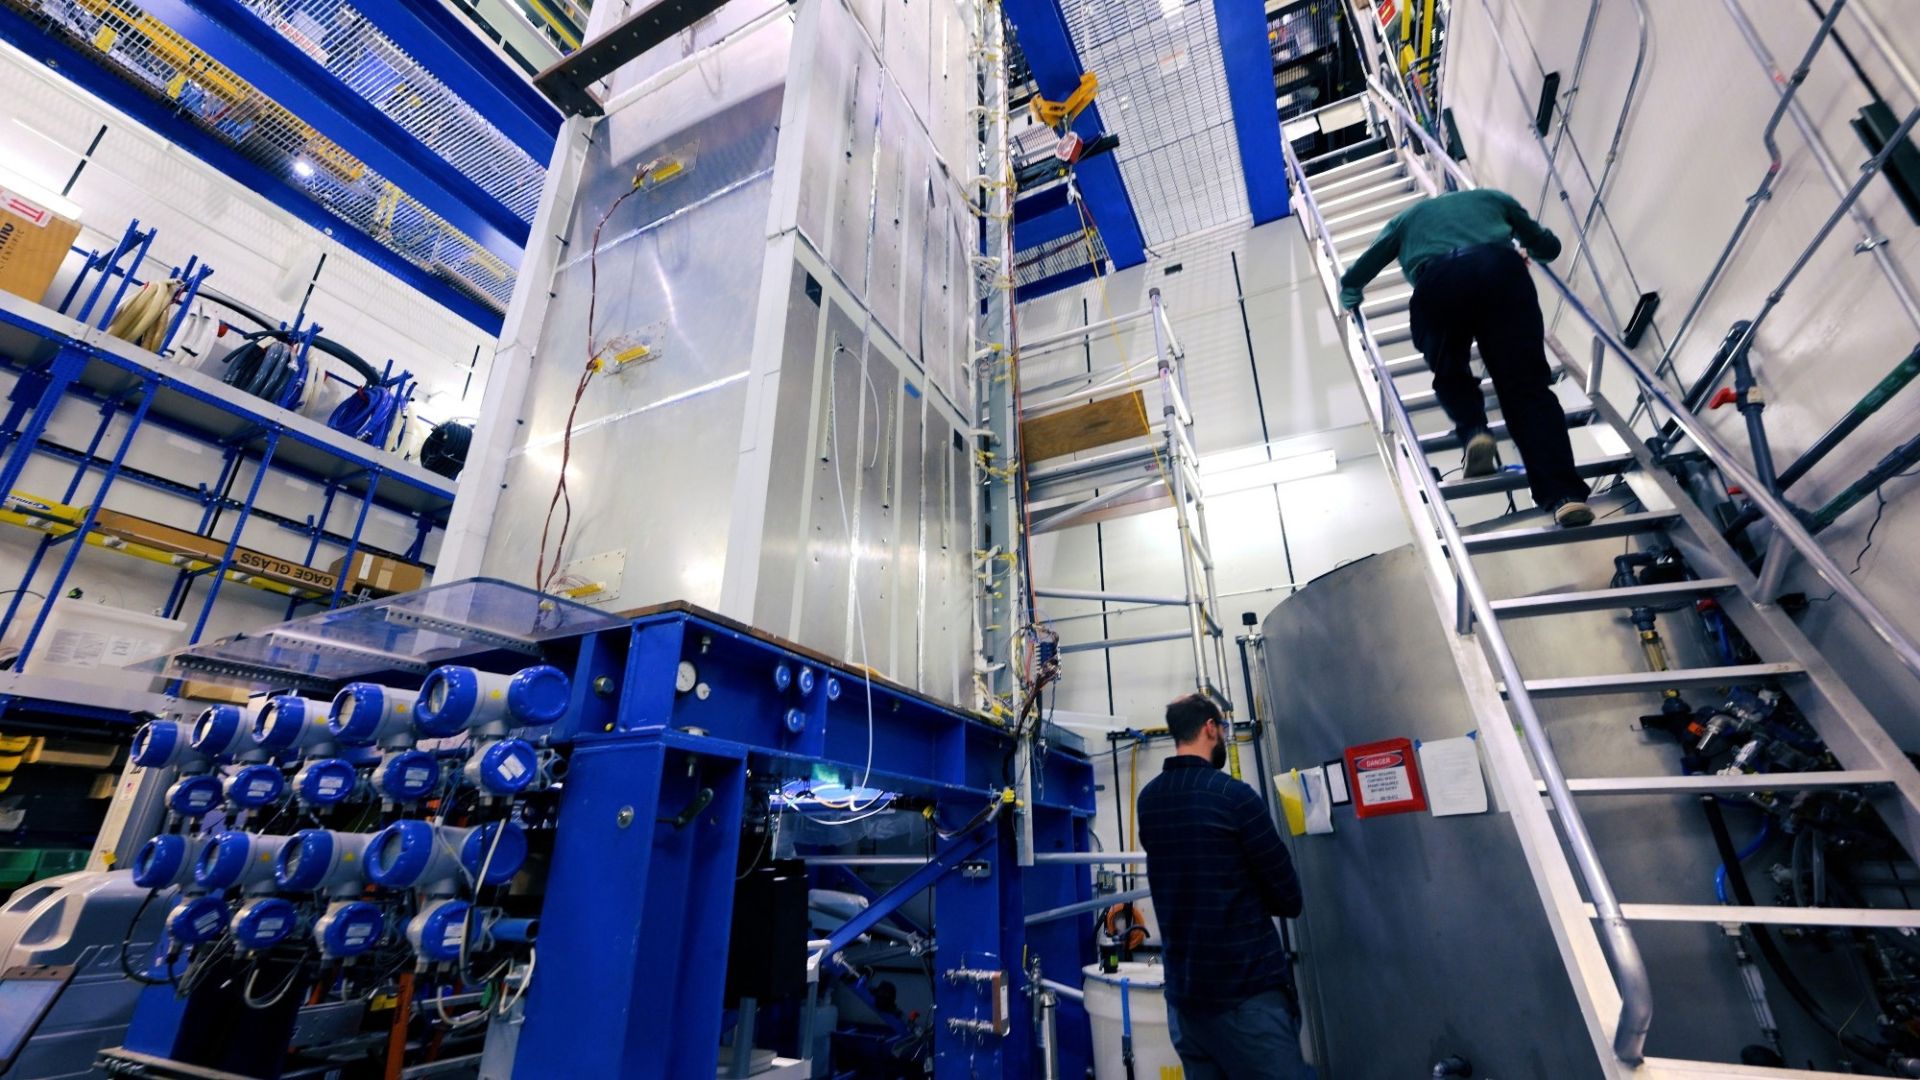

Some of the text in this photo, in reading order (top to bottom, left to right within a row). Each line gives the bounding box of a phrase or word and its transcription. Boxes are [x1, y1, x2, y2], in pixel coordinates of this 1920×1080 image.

[241, 553, 334, 587] GAGE GLASS
[1366, 757, 1391, 768] DANGER
